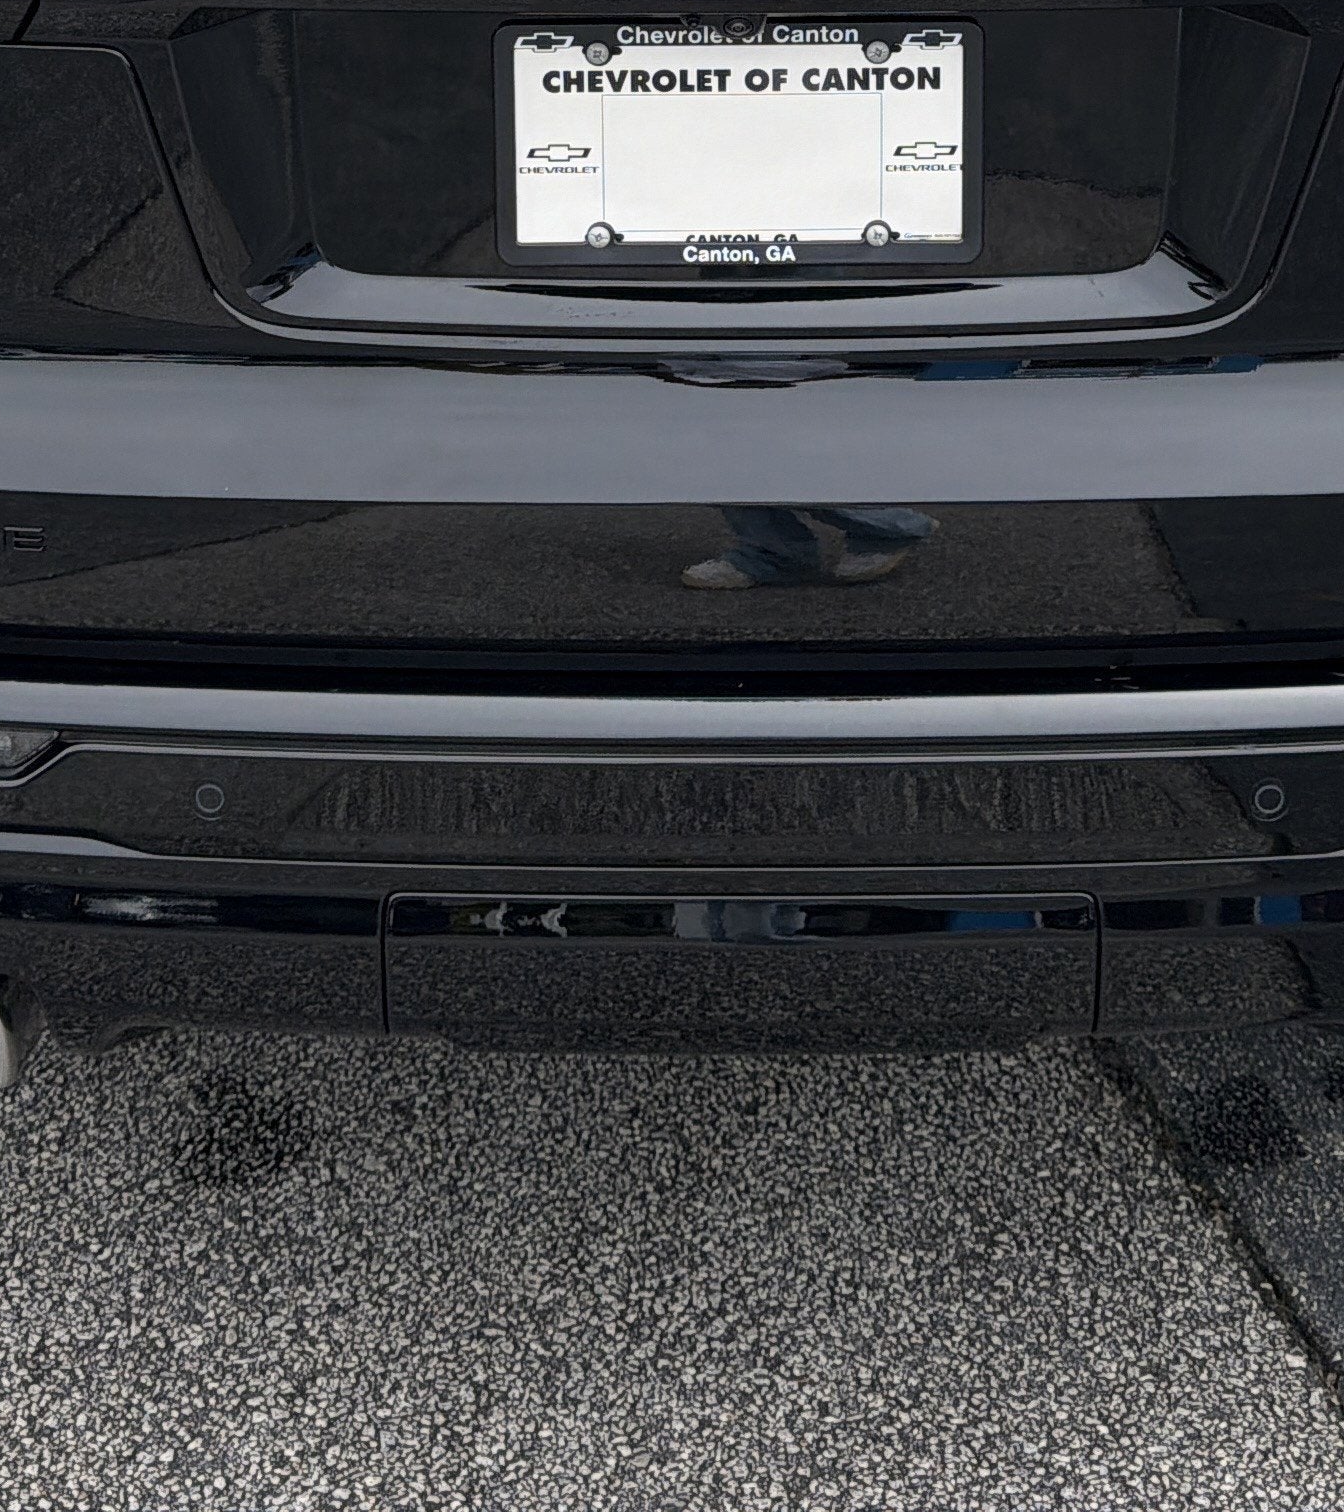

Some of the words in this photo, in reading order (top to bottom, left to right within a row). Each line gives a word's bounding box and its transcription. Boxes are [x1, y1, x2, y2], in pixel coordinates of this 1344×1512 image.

[772, 24, 859, 43] Canton
[542, 69, 732, 93] CHEVROLET
[744, 68, 788, 92] OF
[802, 66, 941, 91] CANTON
[518, 166, 600, 174] CHEVROLET
[682, 245, 760, 265] Canton,
[765, 245, 797, 263] GA
